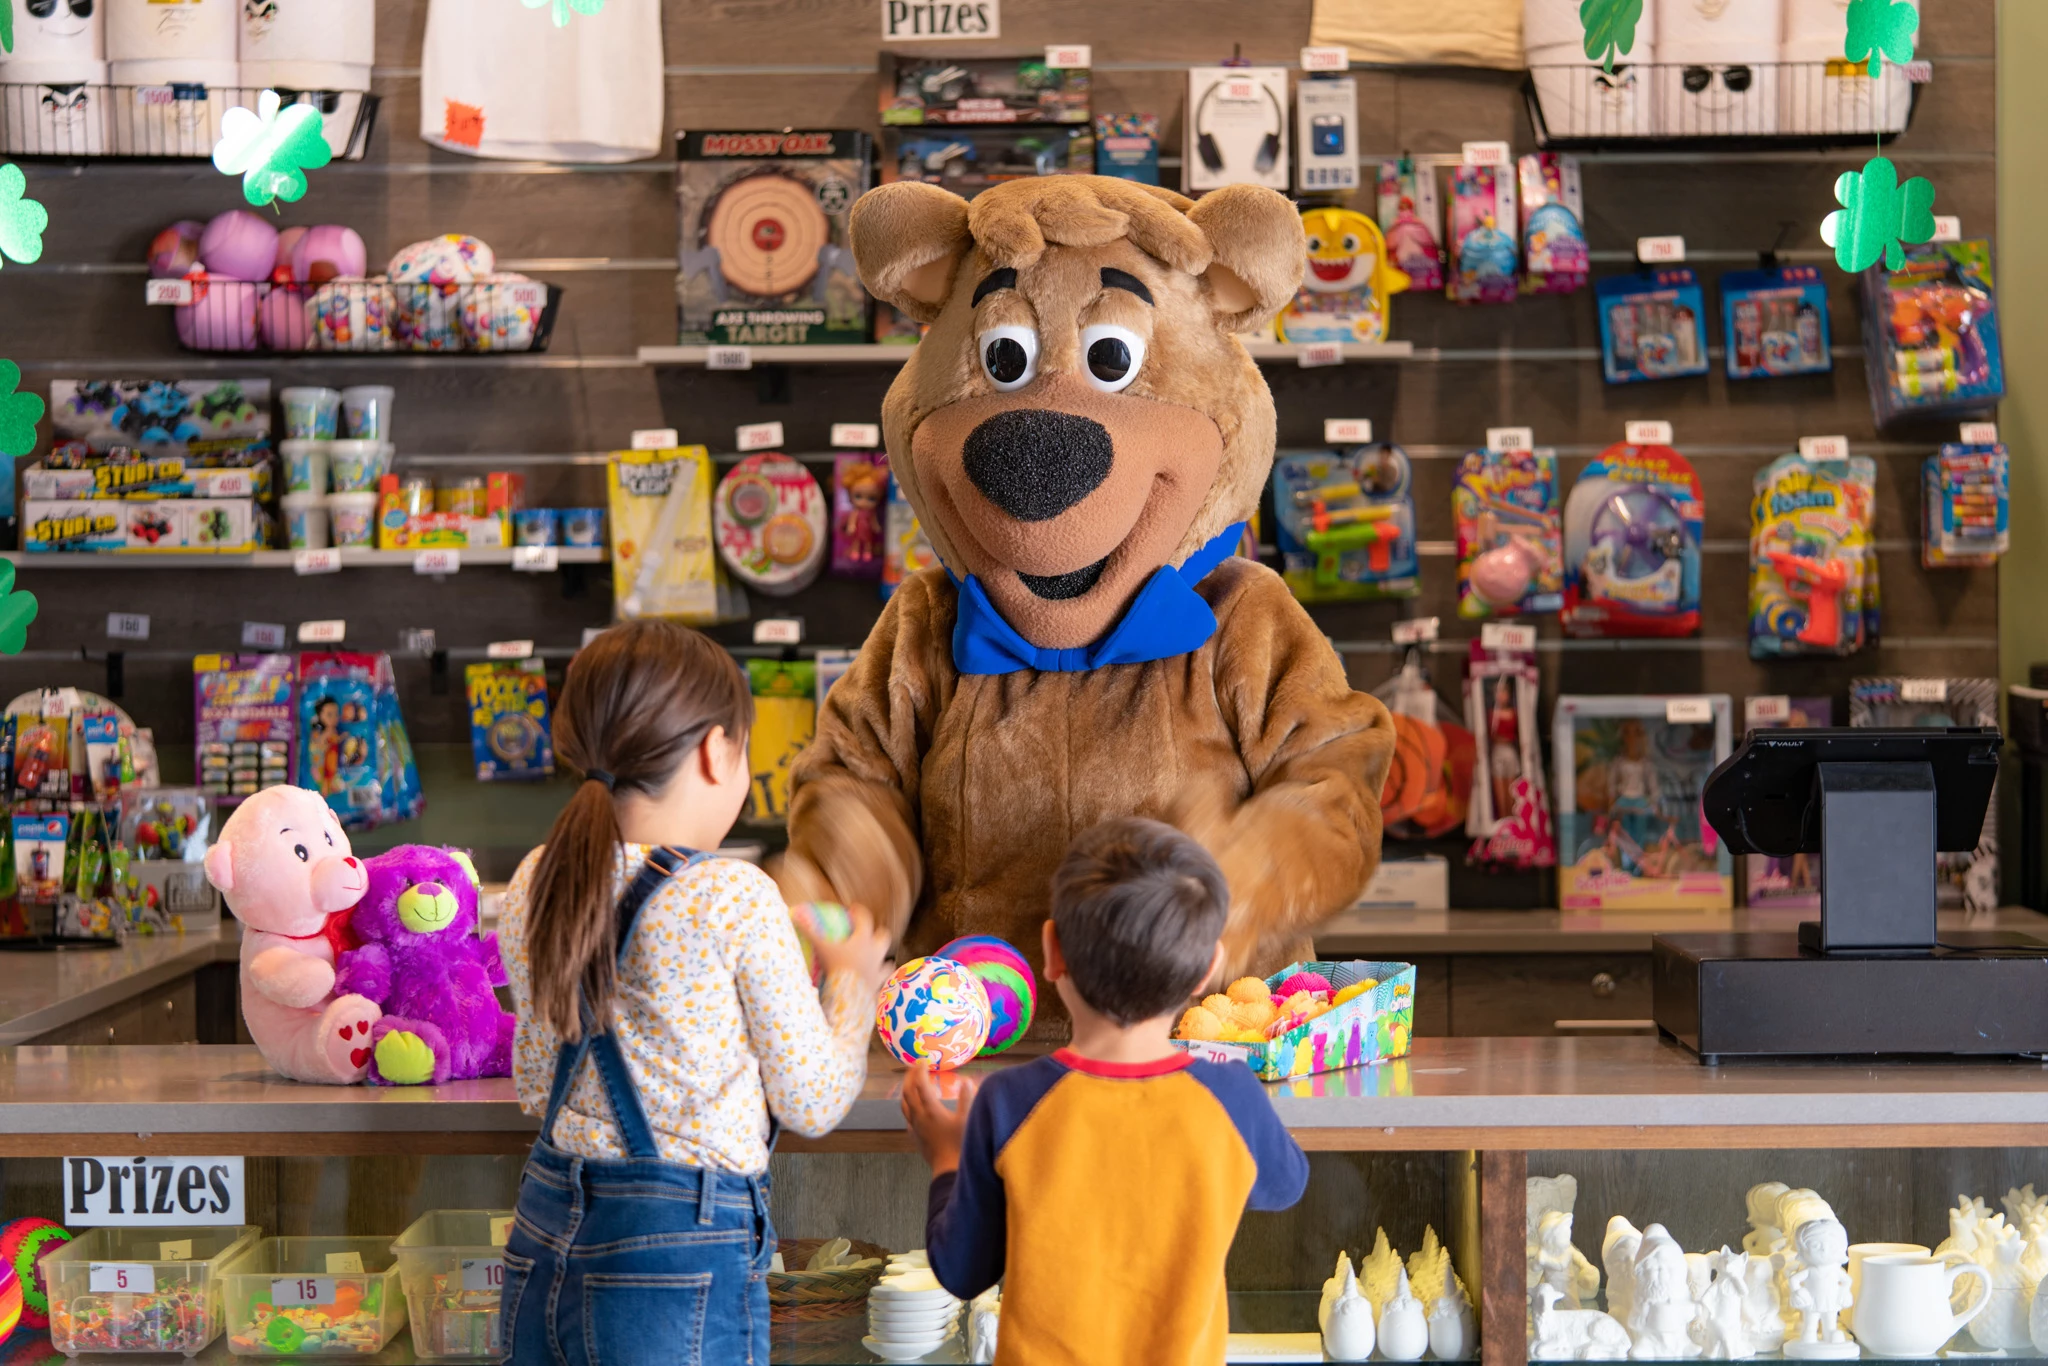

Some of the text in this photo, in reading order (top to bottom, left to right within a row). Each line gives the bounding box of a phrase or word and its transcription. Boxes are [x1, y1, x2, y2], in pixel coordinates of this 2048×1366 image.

[888, 0, 990, 34] Prizes
[703, 134, 831, 156] MOSSY OAK
[715, 311, 825, 325] AXE THROWING
[725, 325, 809, 343] TARGET
[1208, 1050, 1227, 1063] 70
[69, 1156, 231, 1215] Prizes
[117, 1269, 128, 1289] 5
[485, 1268, 504, 1287] 10
[296, 1279, 317, 1300] 15
